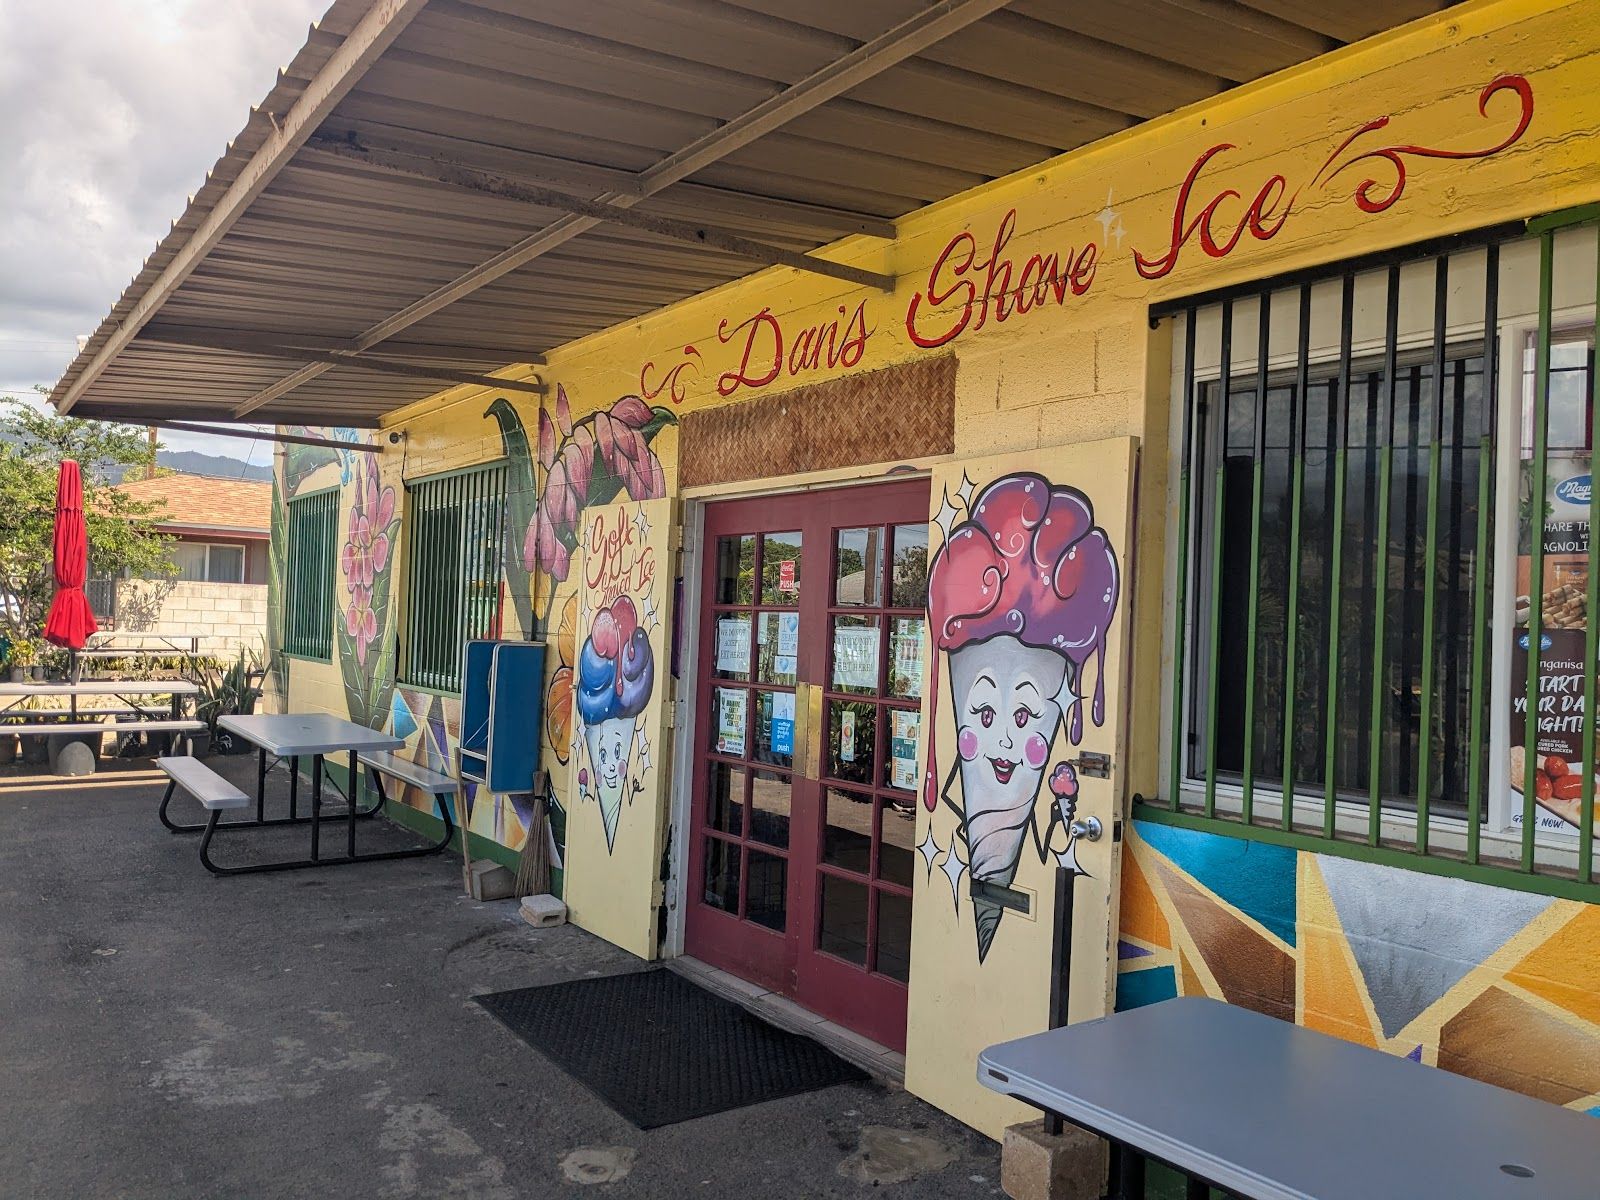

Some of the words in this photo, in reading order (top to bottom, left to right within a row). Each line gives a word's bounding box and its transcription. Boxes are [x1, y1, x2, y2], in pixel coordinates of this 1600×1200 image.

[717, 296, 875, 395] Dan's
[906, 209, 1103, 348] Shave
[1132, 143, 1294, 280] Ice
[1560, 481, 1592, 498] Magn
[1543, 521, 1573, 533] HARE
[1577, 521, 1591, 532] TH
[1543, 541, 1590, 553] AGNOLI
[1539, 659, 1584, 671] nganisa
[1525, 674, 1586, 694] TART
[1561, 695, 1585, 712] DA
[1525, 715, 1585, 733] IGHT!
